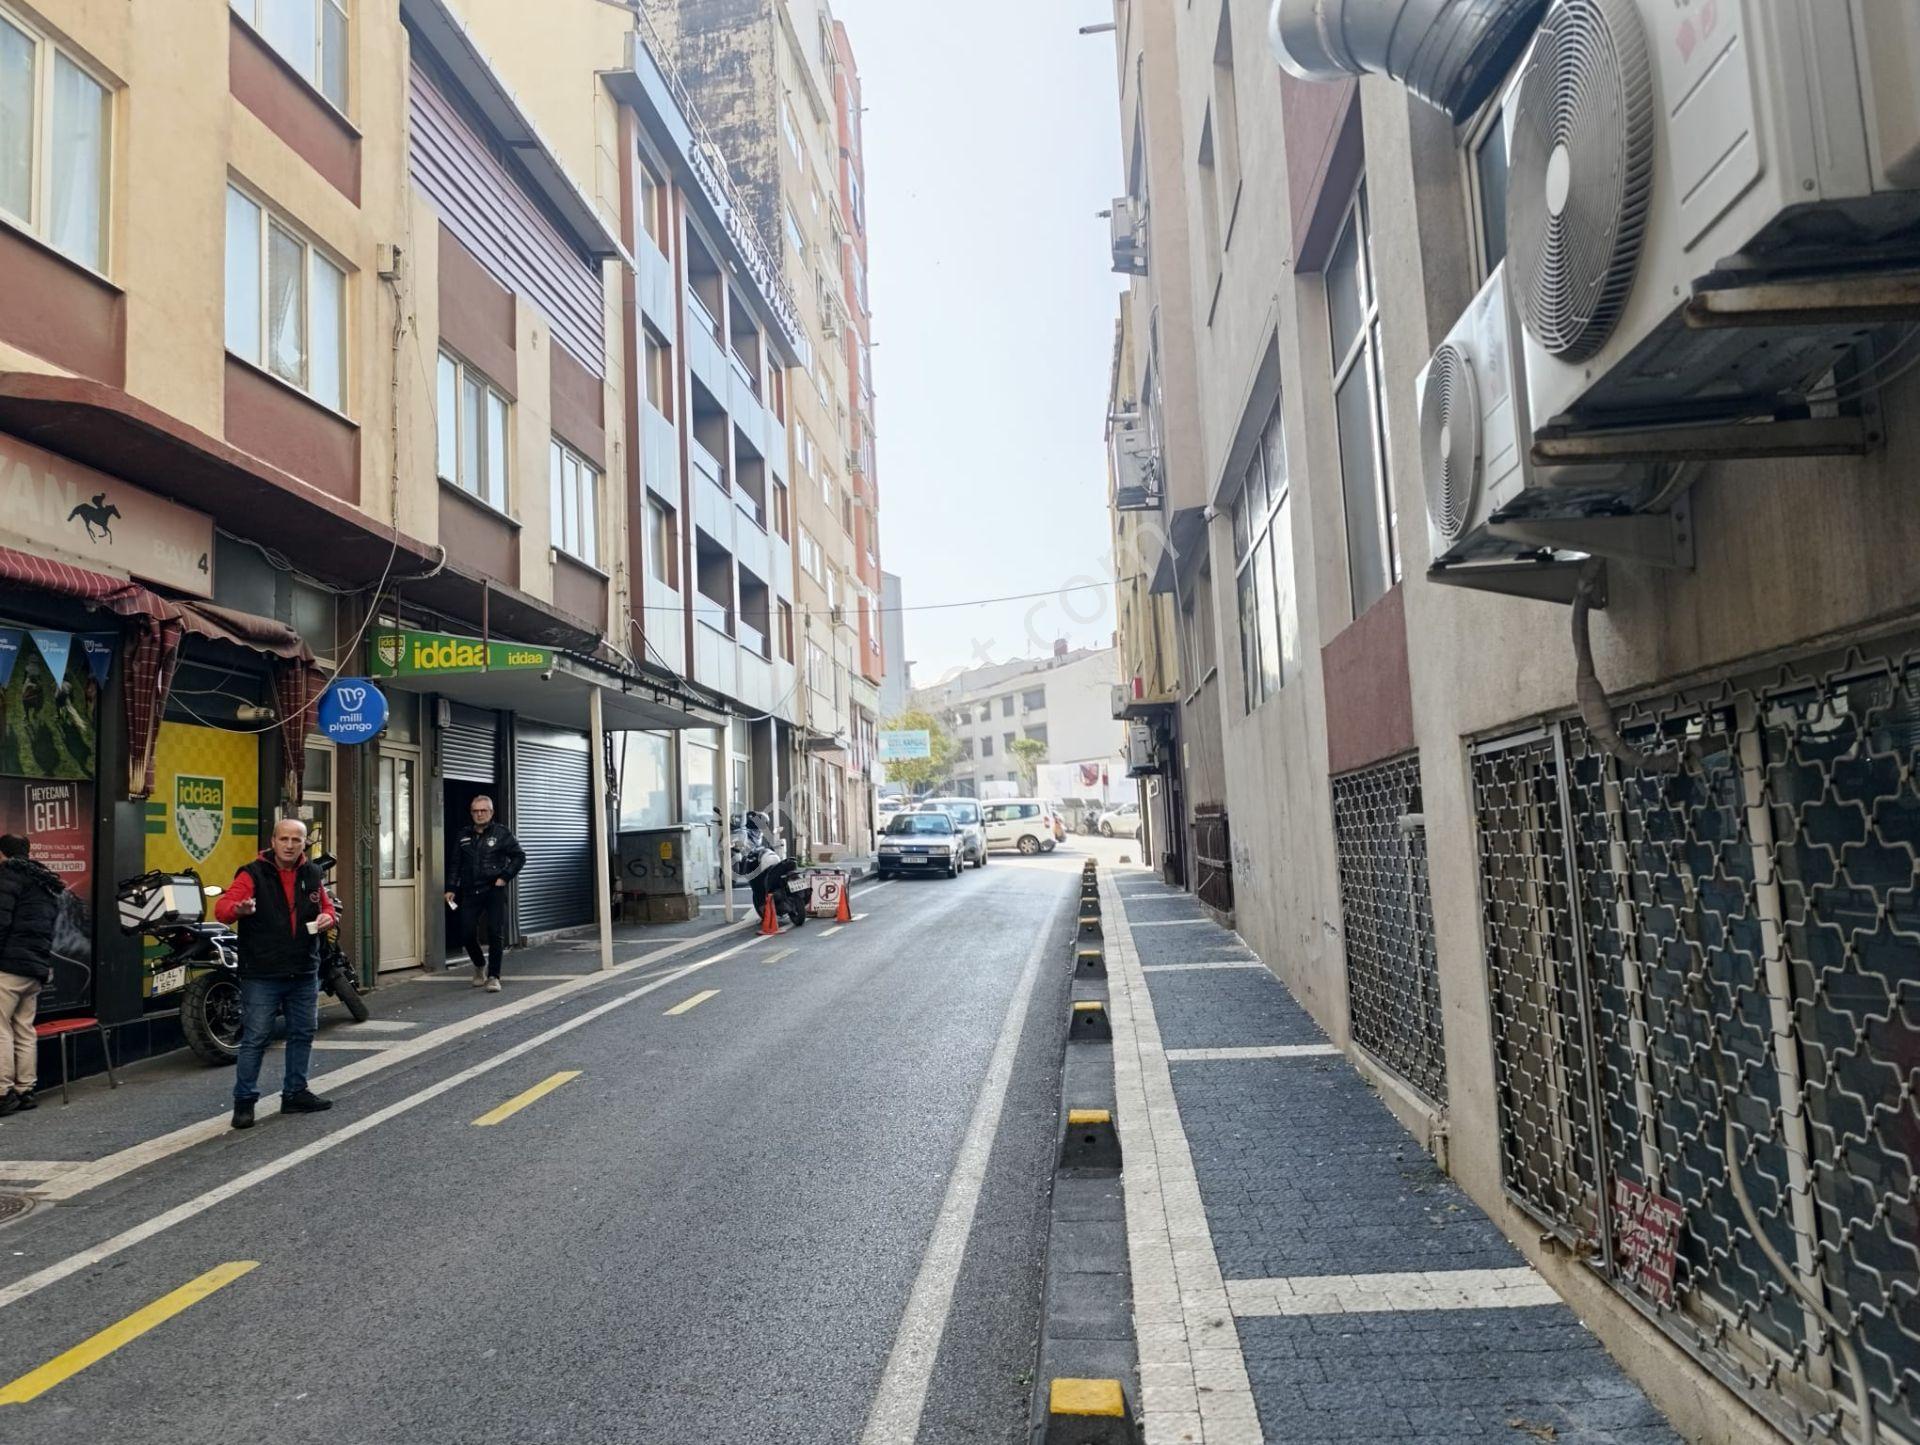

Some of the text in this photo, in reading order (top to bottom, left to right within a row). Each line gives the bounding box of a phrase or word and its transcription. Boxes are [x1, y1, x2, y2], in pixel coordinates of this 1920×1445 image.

[0, 455, 78, 536] AN
[197, 552, 210, 575] 4
[414, 640, 543, 669] iddaa iddaa
[329, 721, 372, 732] piyango
[340, 713, 363, 722] milli
[31, 785, 70, 801] HEYECANA
[179, 780, 221, 804] iddaa
[34, 801, 71, 833] GEL!
